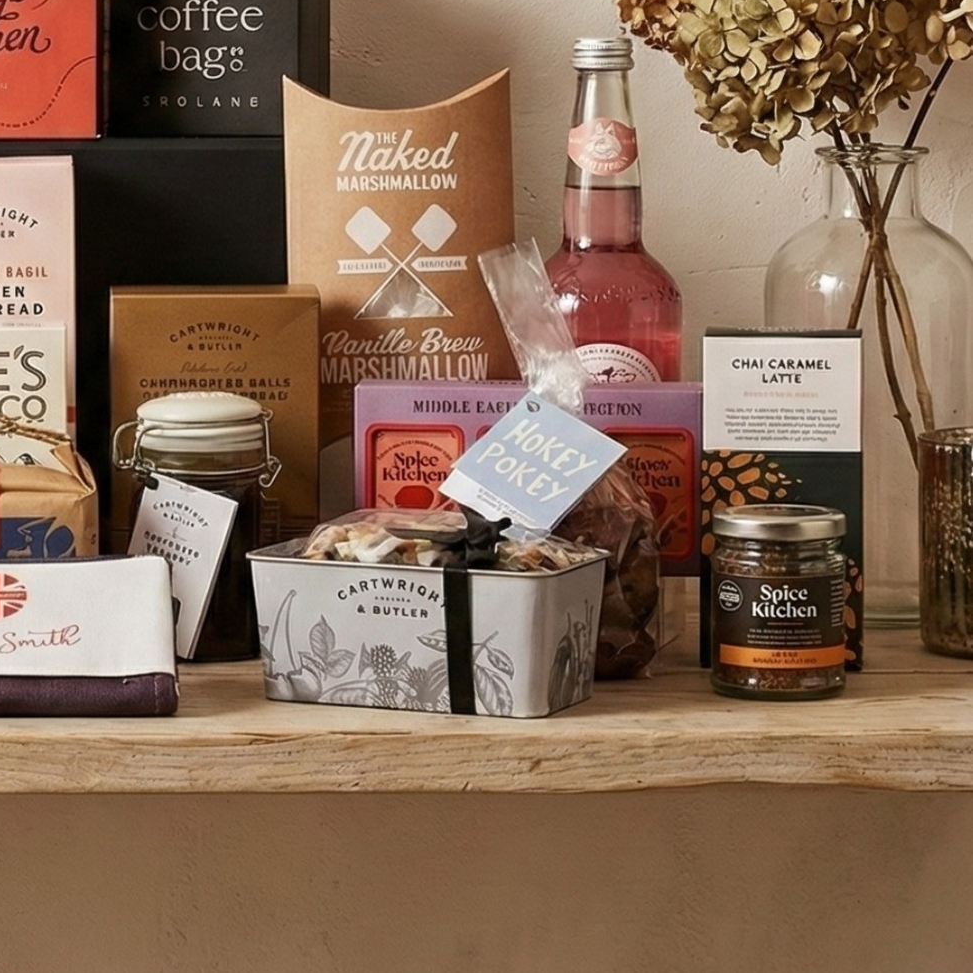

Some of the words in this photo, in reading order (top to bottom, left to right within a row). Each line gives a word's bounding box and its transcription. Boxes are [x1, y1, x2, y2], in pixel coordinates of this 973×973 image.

[159, 40, 228, 80] bag
[377, 131, 398, 145] THE
[337, 128, 460, 172] Naked
[336, 173, 458, 192] MARSHMALLOW
[420, 327, 485, 354] Brew
[320, 353, 489, 384] MARSHMALLOW
[732, 358, 764, 370] CHAI
[768, 358, 832, 370] CARAMEL
[762, 373, 802, 384] LATTE
[413, 400, 471, 414] MIDDLE
[502, 418, 600, 477] HOKEY
[475, 441, 570, 504] POKEY
[759, 583, 809, 605] Spice
[372, 605, 429, 619] BUTLER
[751, 601, 818, 619] Kitchen
